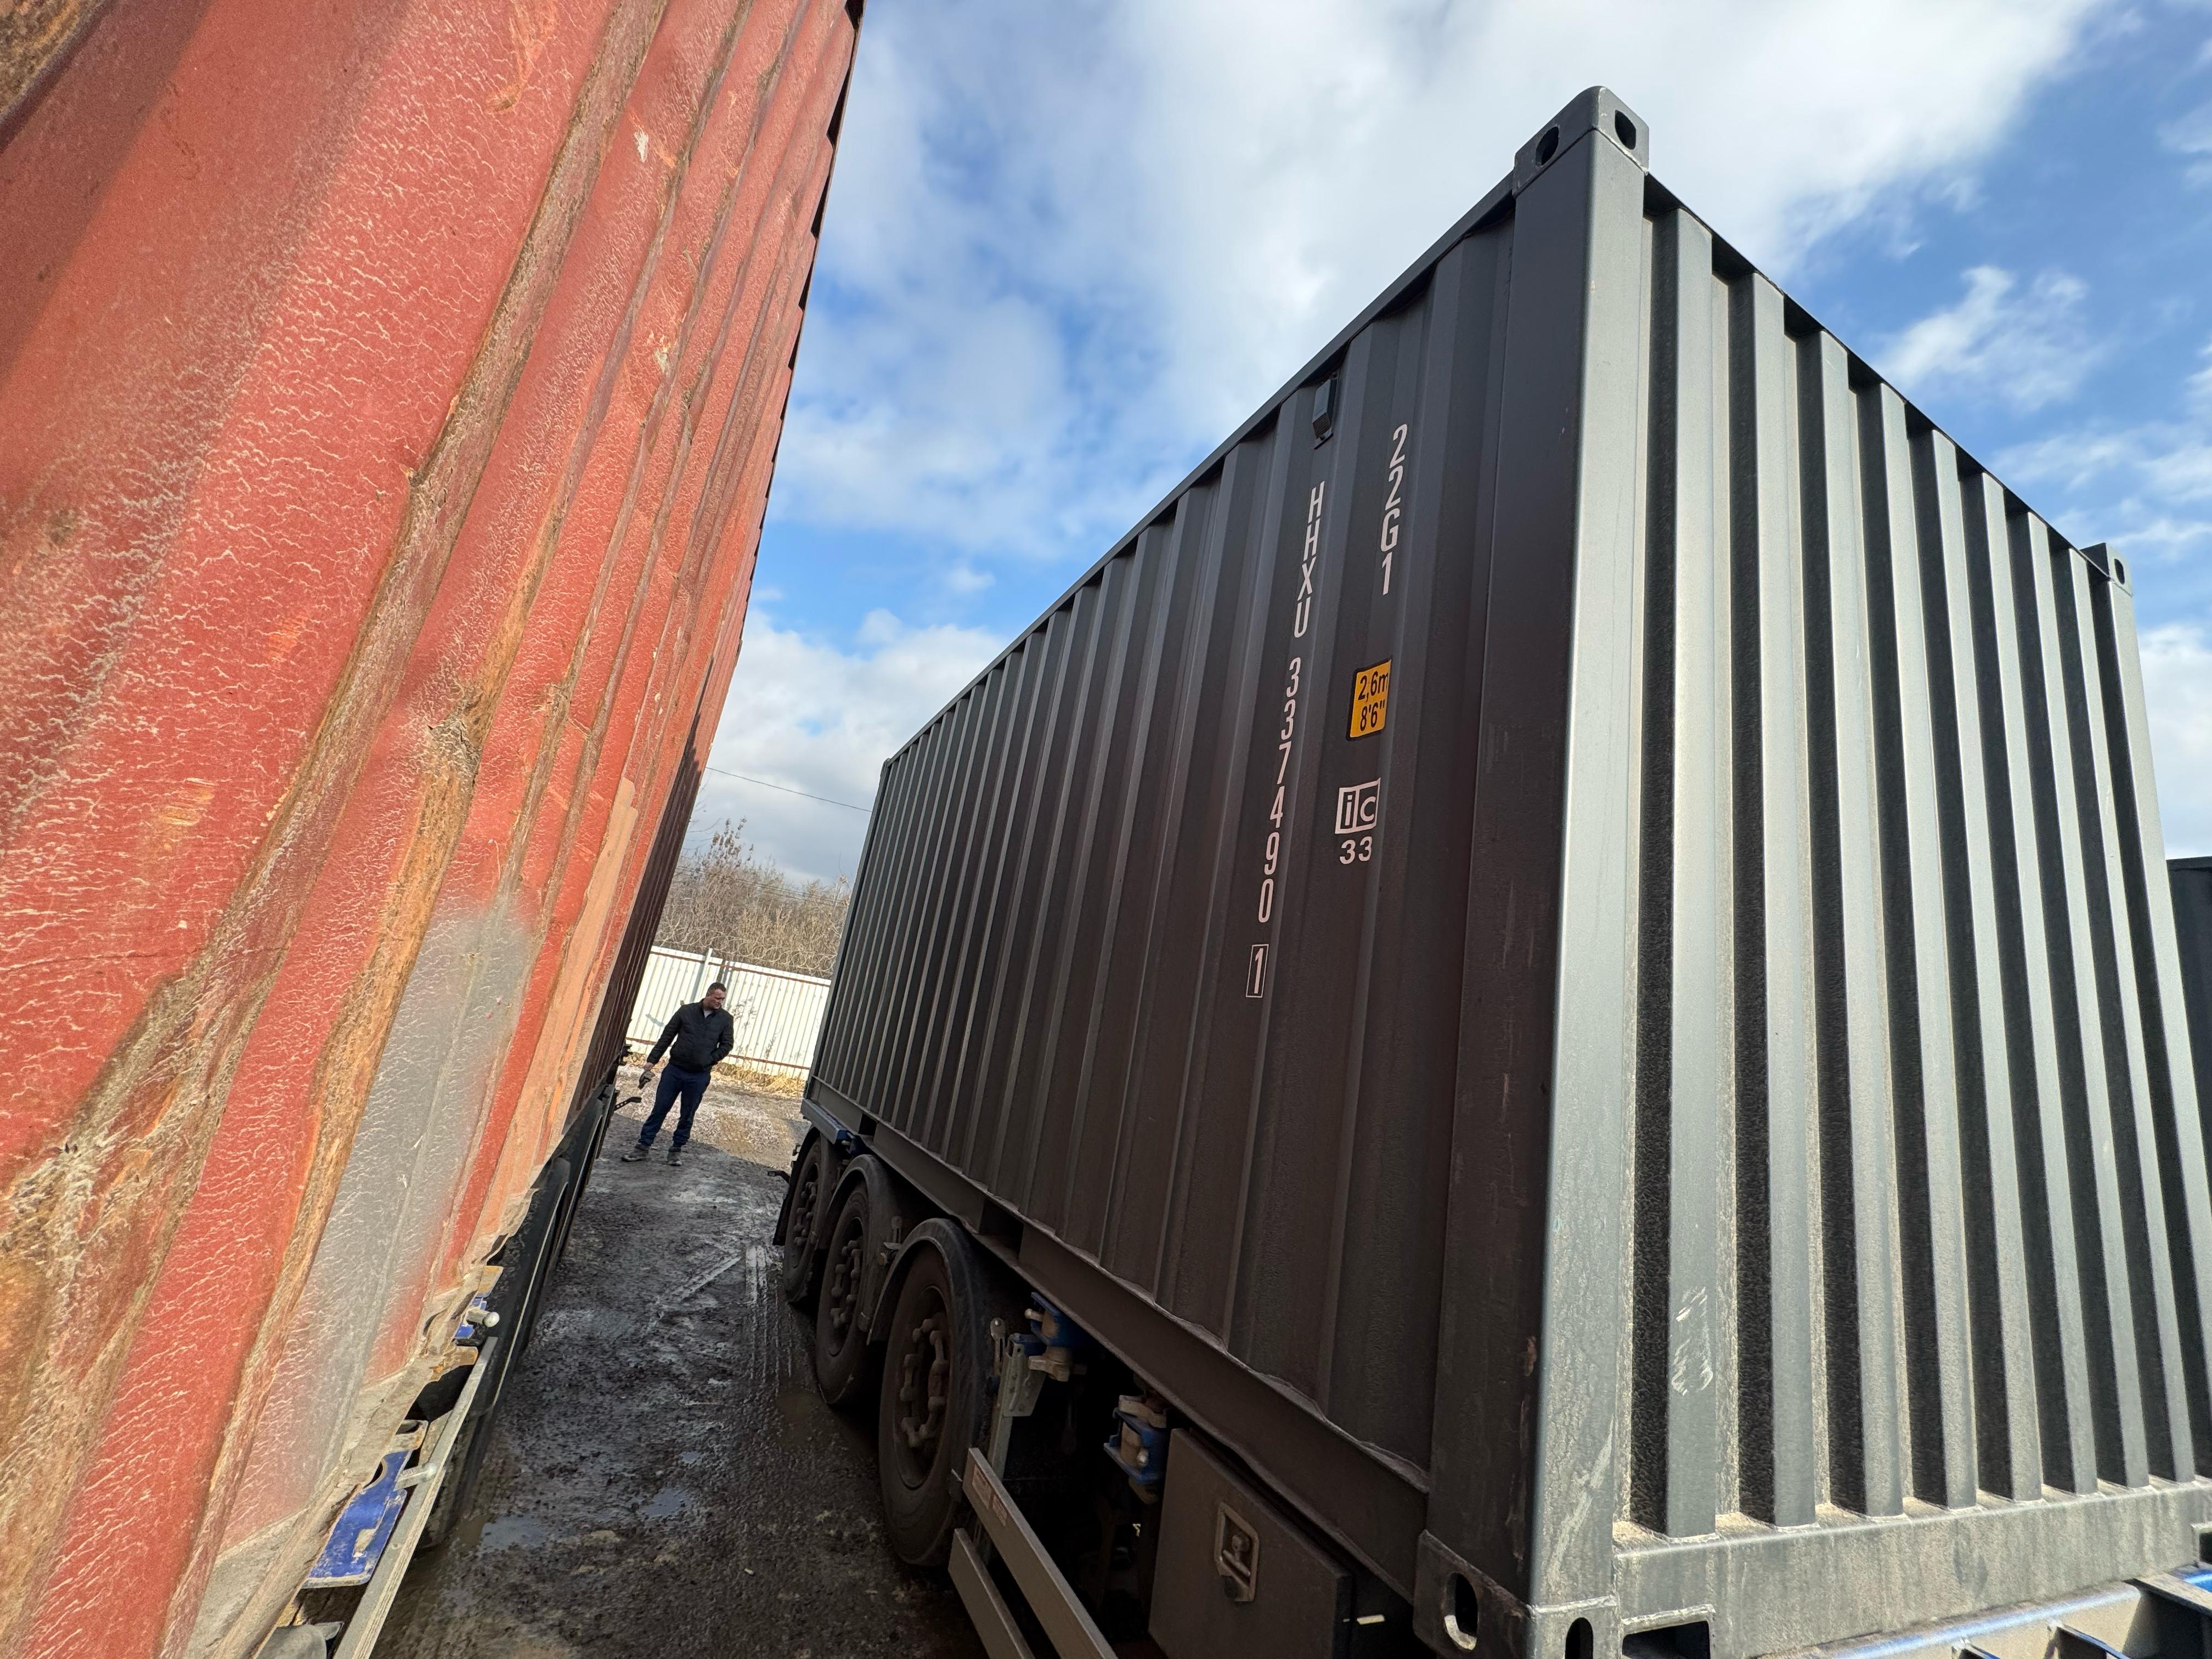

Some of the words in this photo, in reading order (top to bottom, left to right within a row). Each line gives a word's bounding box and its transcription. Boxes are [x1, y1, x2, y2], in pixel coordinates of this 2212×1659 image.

[1294, 481, 1325, 639] HHXU
[1380, 423, 1408, 596] 22G1
[1358, 670, 1389, 703] 2,6m
[1258, 657, 1301, 923] 337490
[1339, 836, 1373, 865] 33
[1254, 947, 1263, 994] 1
